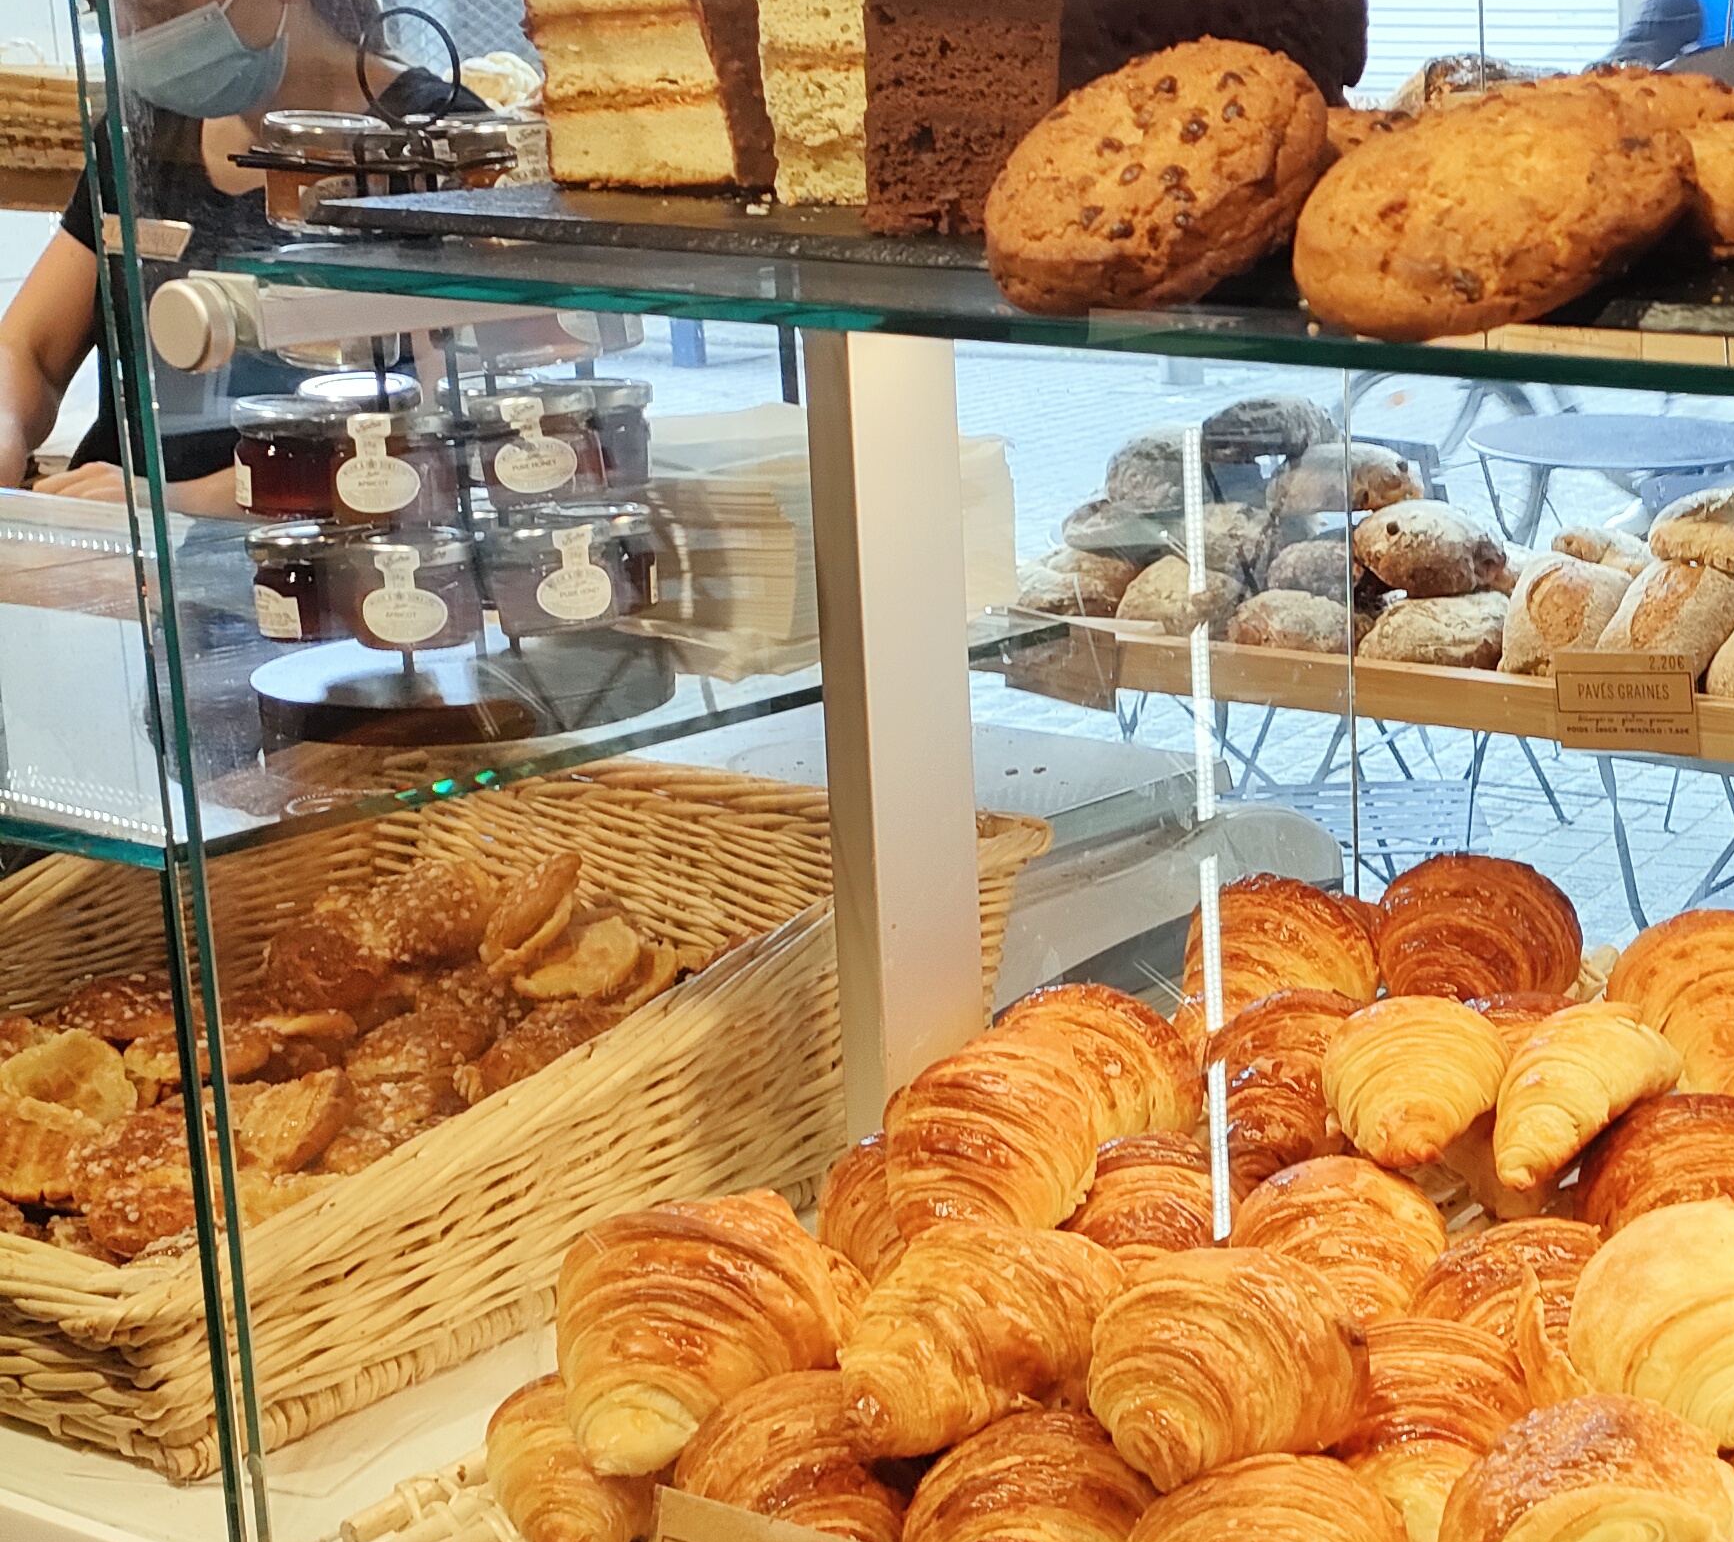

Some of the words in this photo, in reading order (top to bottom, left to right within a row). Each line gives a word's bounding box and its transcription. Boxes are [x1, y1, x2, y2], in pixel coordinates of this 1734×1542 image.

[1649, 655, 1685, 671] 2,20€
[1578, 682, 1615, 701] PAVÉS
[1618, 684, 1670, 700] GRAINES
